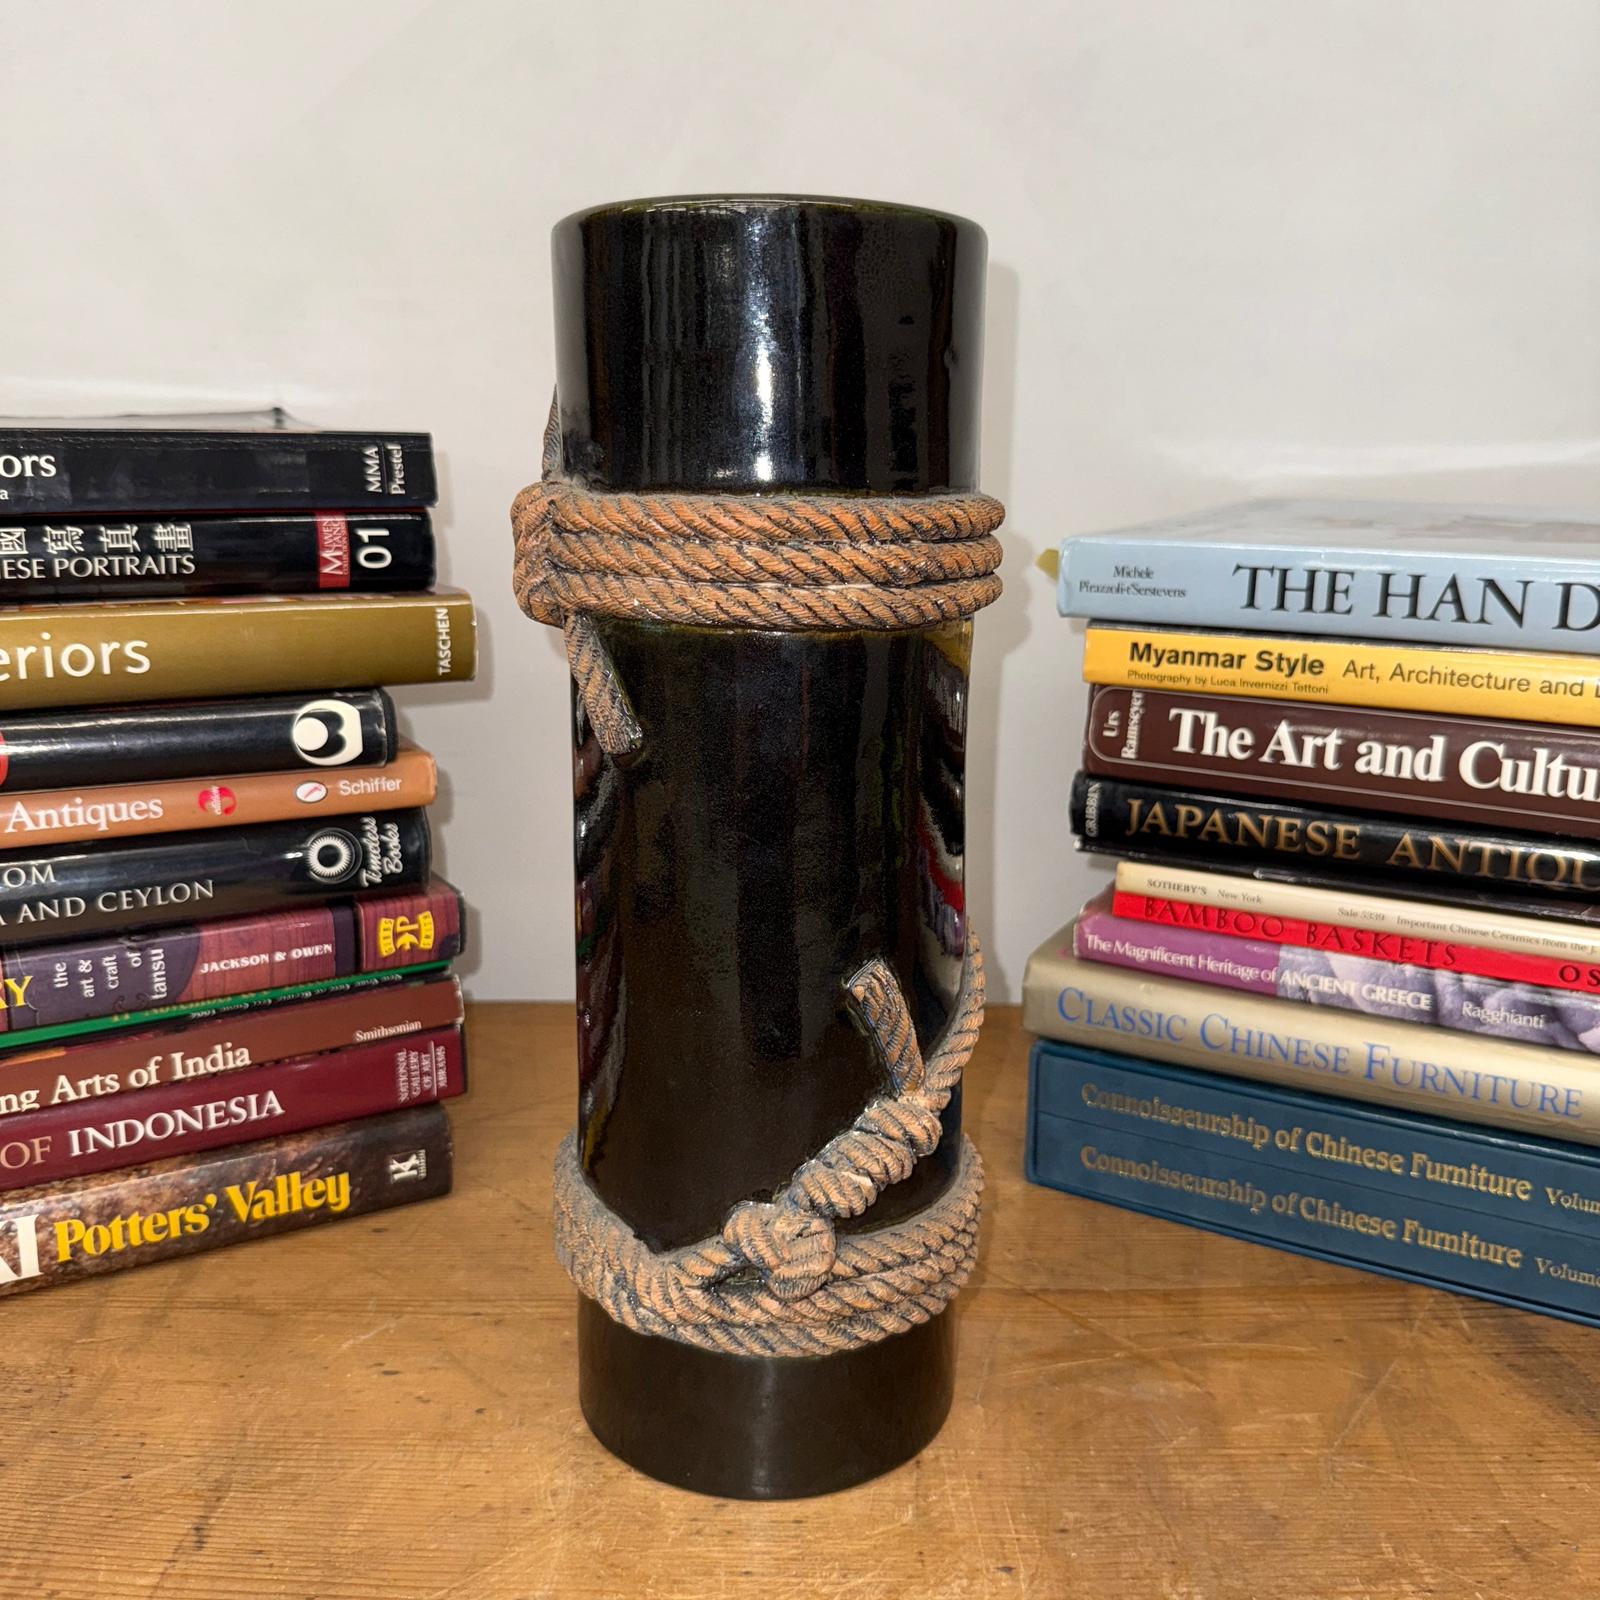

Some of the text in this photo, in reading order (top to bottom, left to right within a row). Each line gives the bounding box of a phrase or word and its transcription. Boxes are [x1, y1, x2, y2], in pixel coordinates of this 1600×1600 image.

[0, 454, 57, 478] ors
[362, 445, 382, 493] MMA
[385, 442, 406, 495] Prestel
[53, 554, 196, 578] PORTRAITS
[354, 528, 393, 569] 01
[1113, 565, 1155, 581] Michele
[1232, 562, 1355, 615] THE
[1372, 573, 1534, 629] HAN
[0, 632, 151, 682] eriors
[435, 607, 451, 675] TASCHEN
[1128, 670, 1191, 685] Photography
[1195, 676, 1207, 687] by
[1211, 677, 1237, 688] Luca
[1239, 679, 1288, 691] Invernizzi
[1129, 642, 1246, 670] Myanmar
[1255, 650, 1325, 677] Style
[1342, 659, 1381, 684] Art,
[1389, 663, 1531, 693] Architecture
[1539, 680, 1584, 698] and
[1103, 710, 1121, 738] Urs
[1120, 691, 1145, 760] Ramseyer
[1168, 708, 1600, 802] The Art and Cultu
[339, 777, 403, 796] Schiffer
[4, 797, 164, 833] Antiques
[1125, 798, 1362, 861] JAPANESE
[357, 815, 383, 888] Timeless
[382, 822, 404, 875] Books
[3, 863, 57, 888] OM
[1147, 878, 1263, 905] SOTHEBY'S New York
[16, 896, 86, 924] AND
[97, 879, 214, 913] CEYLON
[1144, 895, 1459, 967] BAMBOO BASKETS
[1337, 907, 1359, 919] Sale
[1396, 915, 1447, 933] Important
[1449, 922, 1490, 938] Chinese
[1491, 929, 1540, 946] Ceramics
[1542, 935, 1567, 948] from
[53, 961, 69, 988] the
[78, 959, 95, 998] art &
[102, 953, 119, 990] craft
[126, 951, 143, 968] of
[150, 948, 168, 1000] tansu
[200, 943, 333, 974] JACKSON & OWEN
[1086, 934, 1433, 1010] The Magnificent Heritage of ANCIENT GREECE
[355, 1020, 422, 1043] Smithsonian
[1462, 1000, 1546, 1030] Ragghianti
[51, 1074, 120, 1104] Arts
[128, 1056, 163, 1089] of
[169, 1042, 252, 1080] India
[395, 1047, 409, 1102] NATIONAL
[408, 1051, 421, 1097] GALLERY
[420, 1053, 431, 1072] ART
[1057, 987, 1584, 1118] CLASSIC CHINESE FURNITURE
[0, 1090, 285, 1169] OF INDONESIA
[1081, 1082, 1270, 1148] Connoisseurship
[1276, 1126, 1302, 1151] of
[1305, 1130, 1403, 1175] Chinese
[1410, 1151, 1533, 1200] Furniture
[55, 1193, 217, 1262] Potters'
[225, 1171, 351, 1223] Valley
[1080, 1146, 1266, 1213] Connoisseurship
[1271, 1190, 1299, 1216] of
[1300, 1197, 1396, 1240] Chinese
[1402, 1219, 1523, 1268] Furniture
